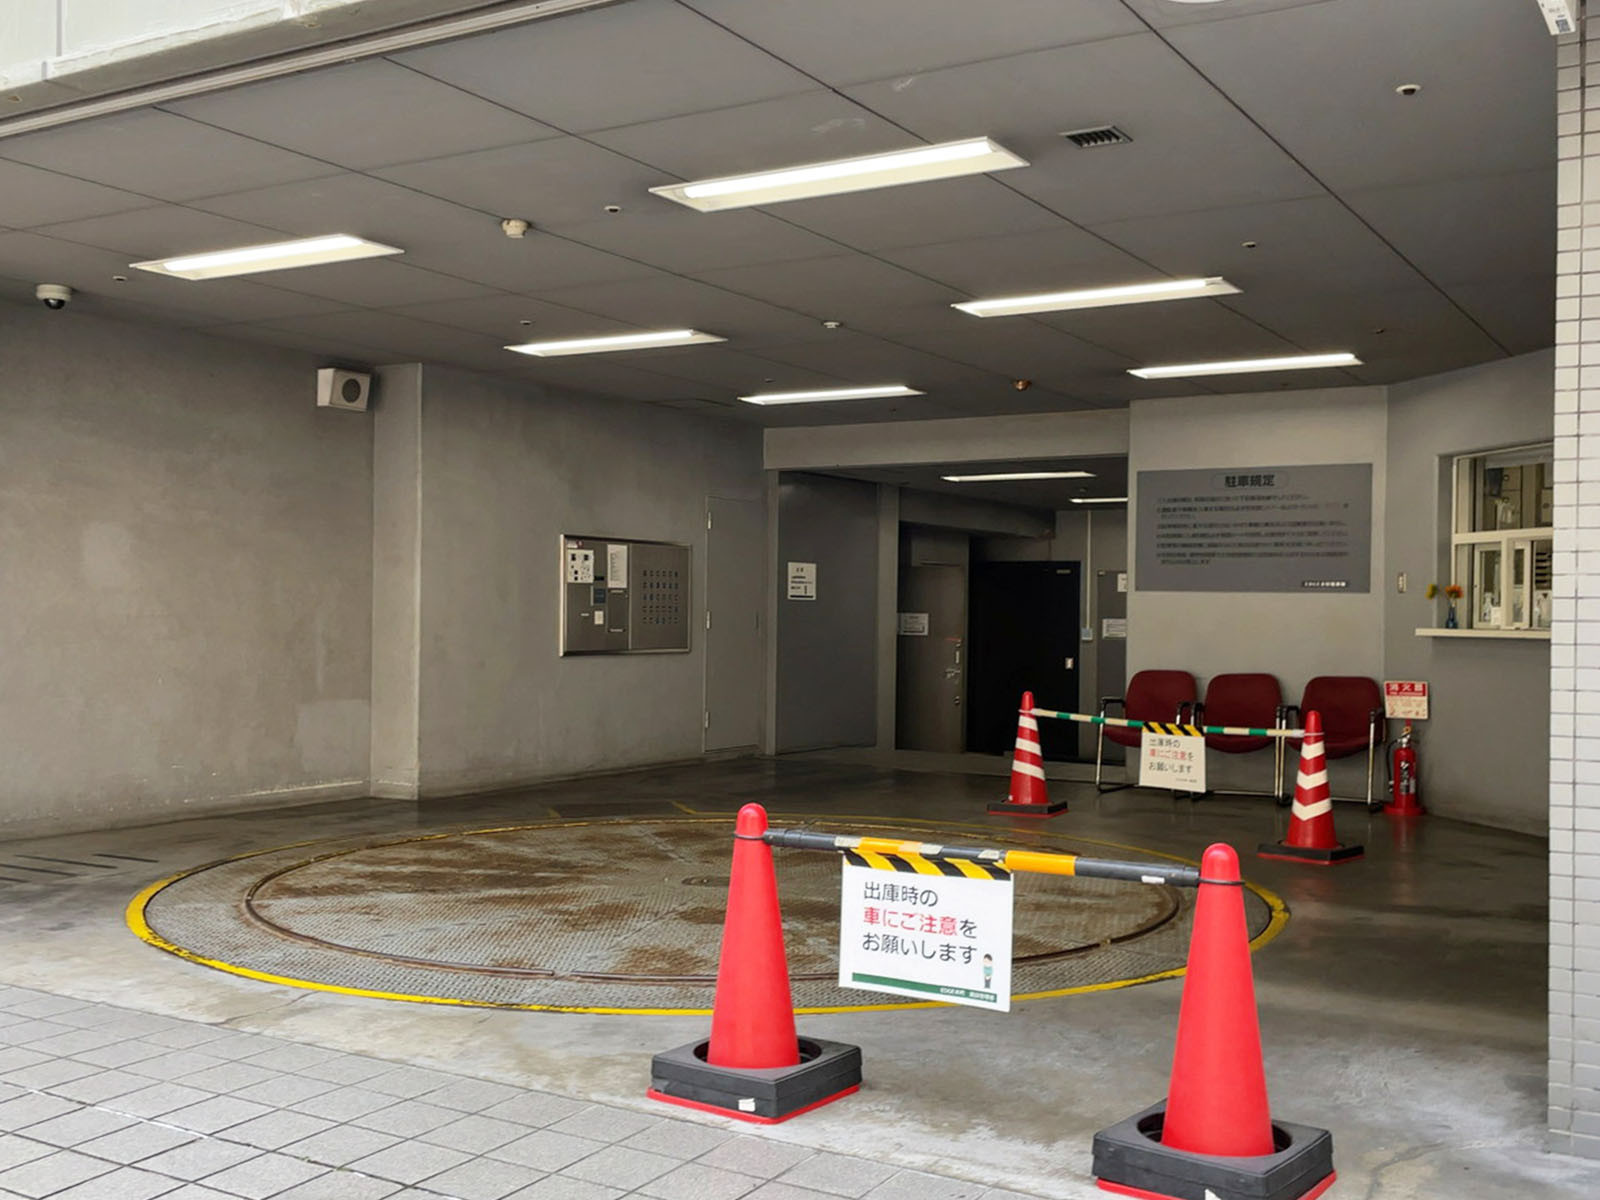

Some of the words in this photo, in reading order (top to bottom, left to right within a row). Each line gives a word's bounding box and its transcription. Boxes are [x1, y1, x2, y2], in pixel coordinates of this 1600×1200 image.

[1225, 474, 1275, 488] 駐車規定
[863, 881, 939, 907] 出庫時の
[863, 907, 978, 939] 車にご注意を
[862, 932, 978, 965] お願いします
